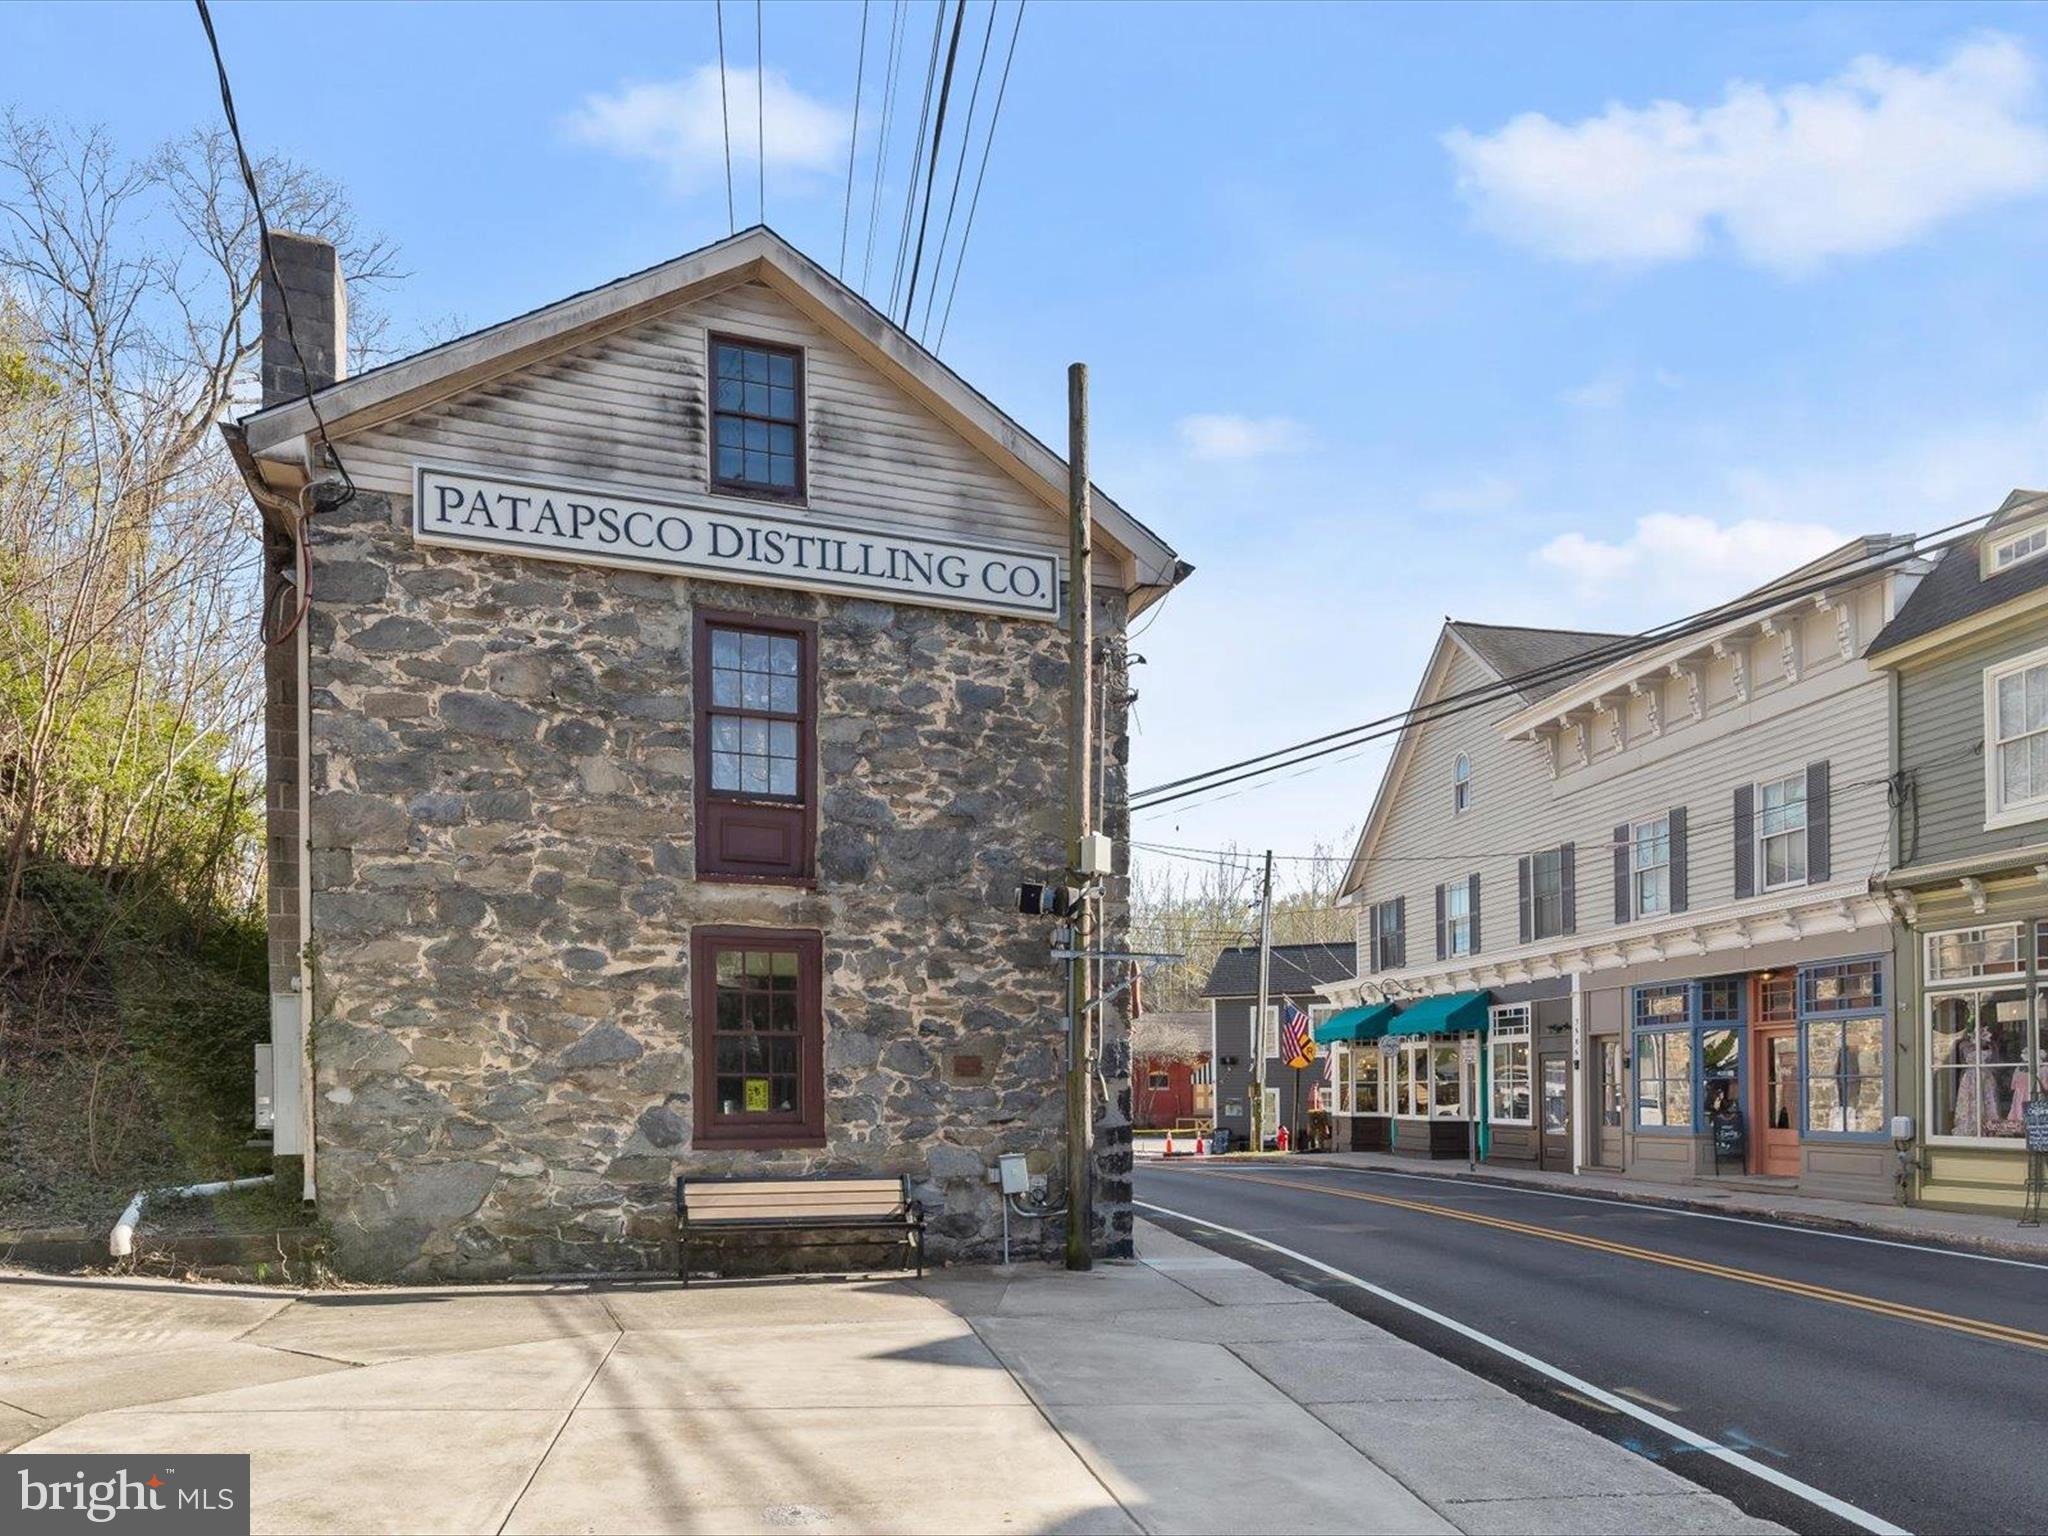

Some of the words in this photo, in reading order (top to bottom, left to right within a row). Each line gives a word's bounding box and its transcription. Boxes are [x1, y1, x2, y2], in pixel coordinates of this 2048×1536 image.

[434, 486, 693, 552] PATAPSCO
[707, 522, 969, 588] DISTILLING
[982, 561, 1047, 600] CO.
